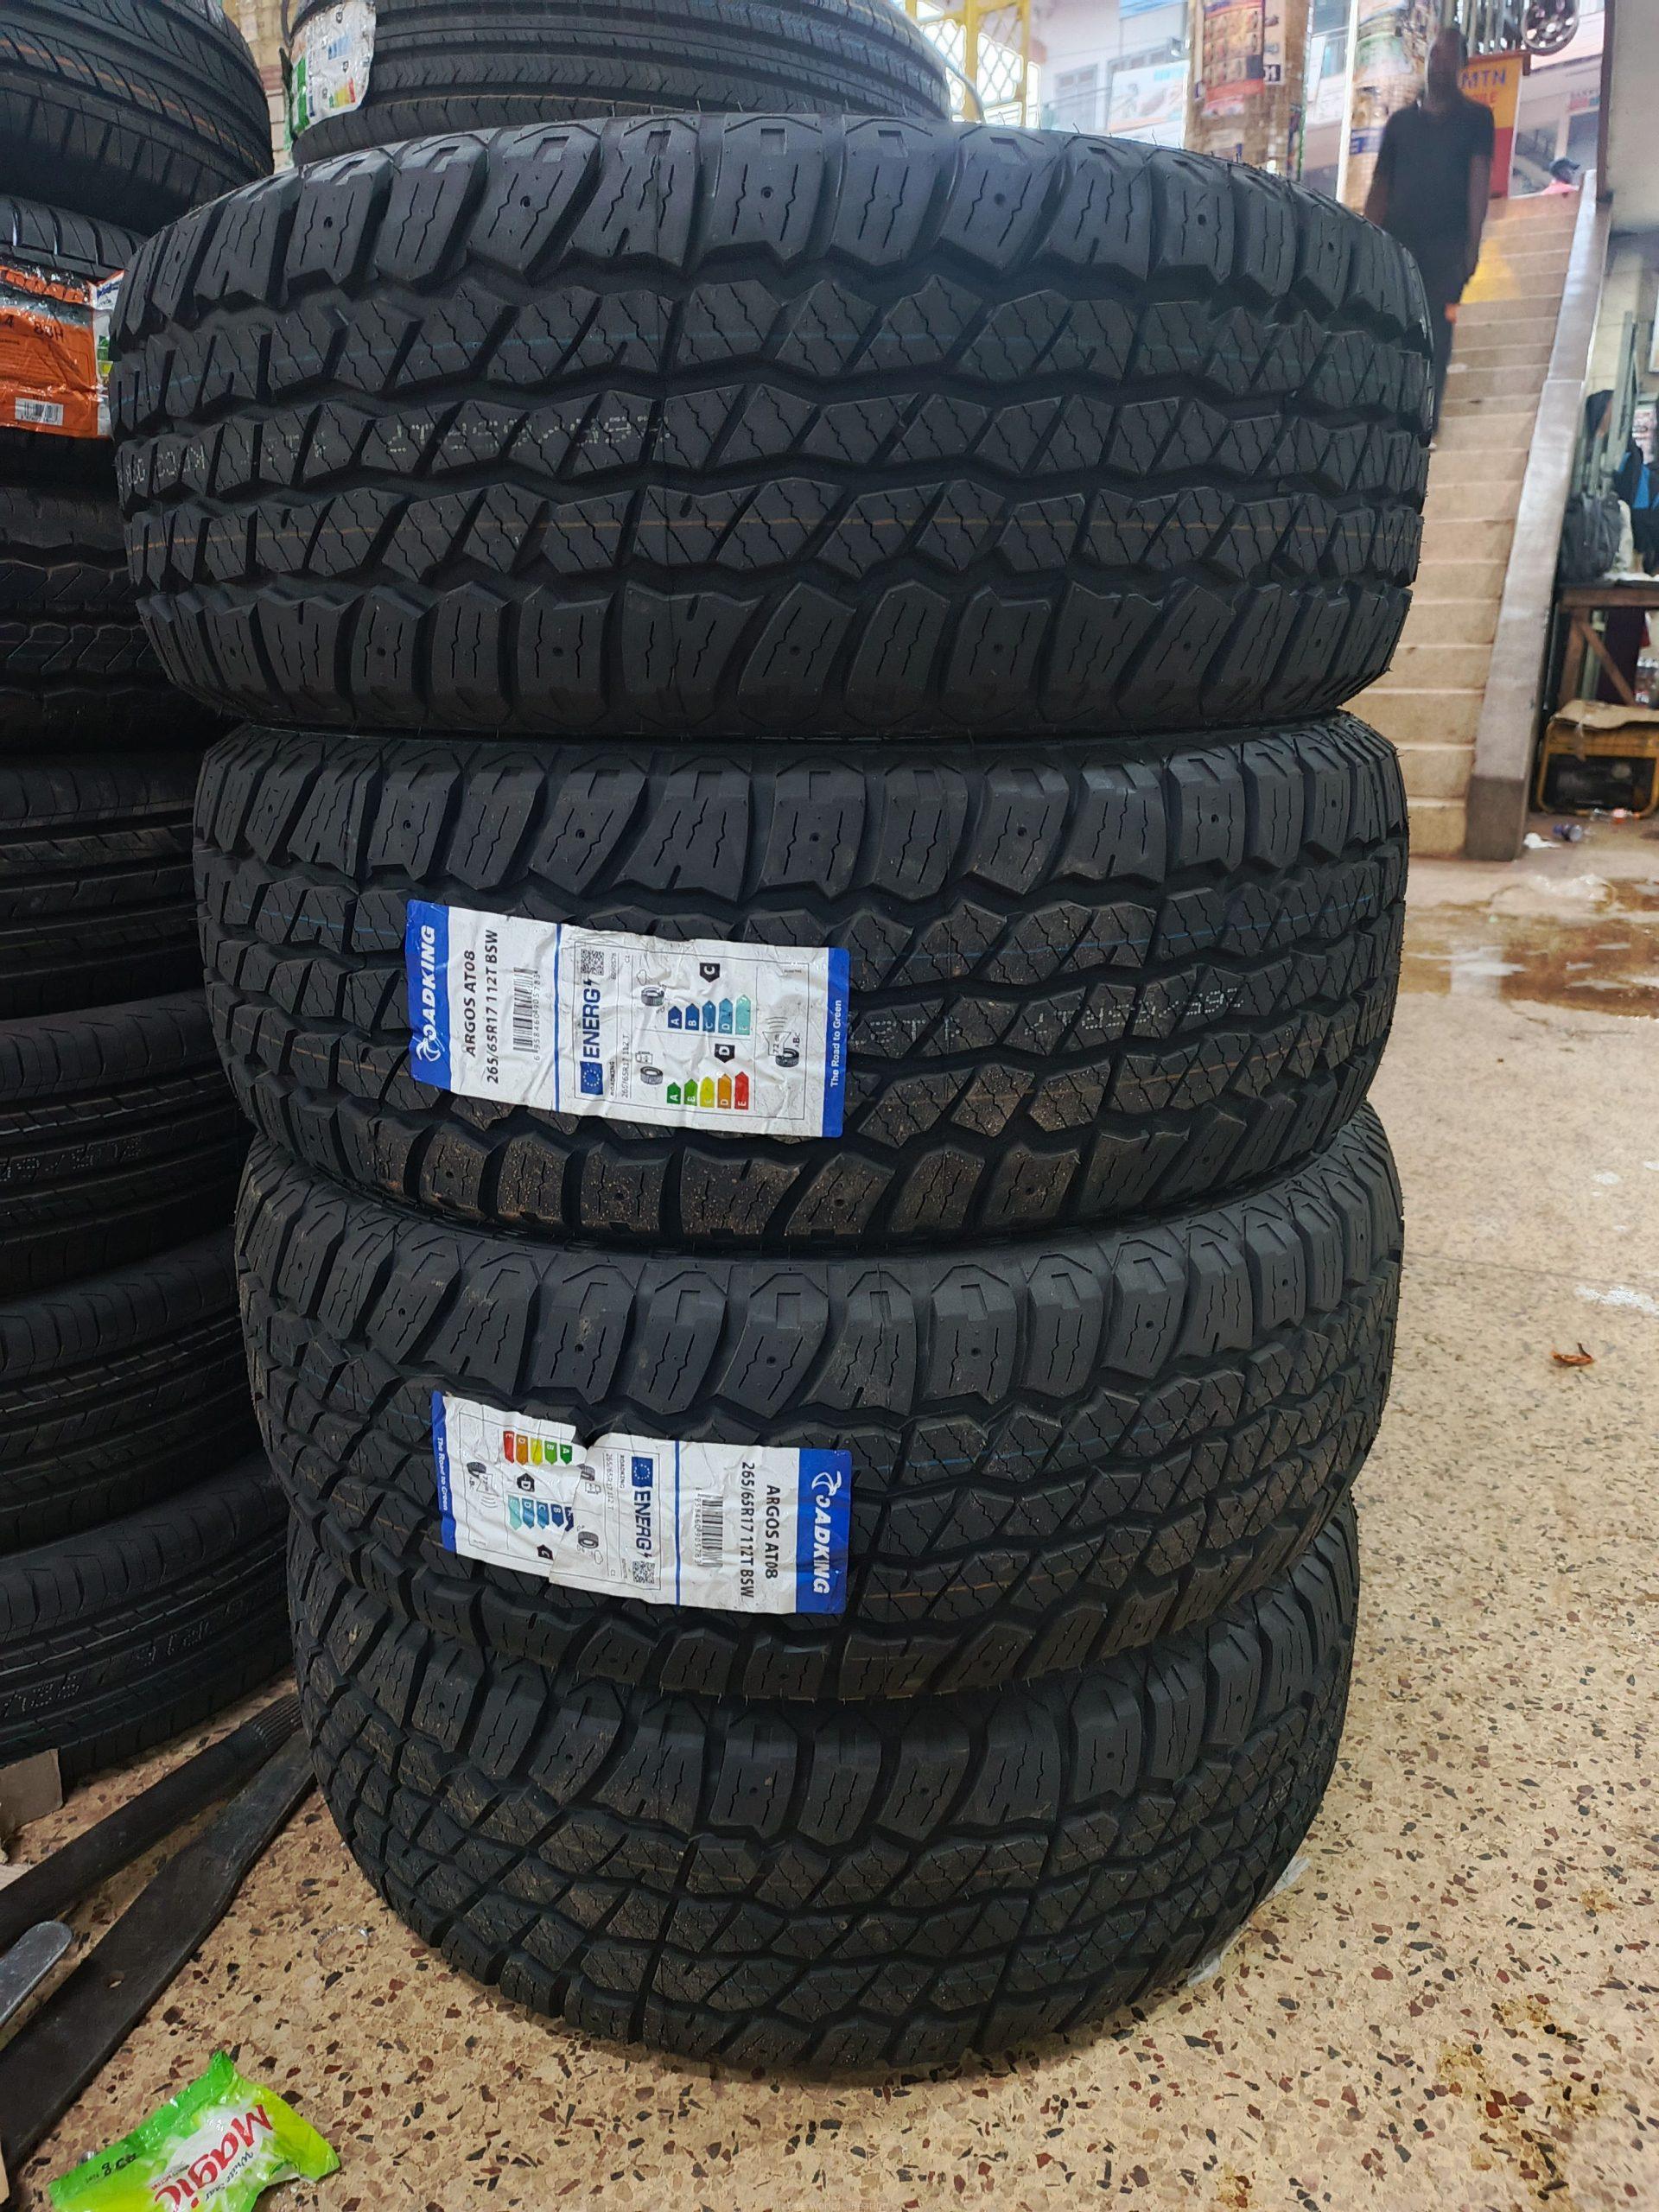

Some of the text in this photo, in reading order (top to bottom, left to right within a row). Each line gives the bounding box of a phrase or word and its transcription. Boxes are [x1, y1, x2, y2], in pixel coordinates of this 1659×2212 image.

[1461, 69, 1507, 88] MTN
[704, 966, 715, 975] C
[463, 950, 476, 1058] ARGOS AT08
[485, 929, 499, 1084] 265/65R17 112T BSW
[582, 988, 601, 1058] ENERG
[719, 1046, 730, 1056] D
[772, 1043, 779, 1054] 72
[830, 1000, 842, 1087] The Road to Green
[520, 1480, 531, 1490] D
[634, 1491, 652, 1550] ENERG
[740, 1462, 755, 1598] 265/65R17 112T BSW
[766, 1485, 780, 1579] ARGOS AT08
[154, 2103, 273, 2212] Magic
[222, 2151, 254, 2185] White
